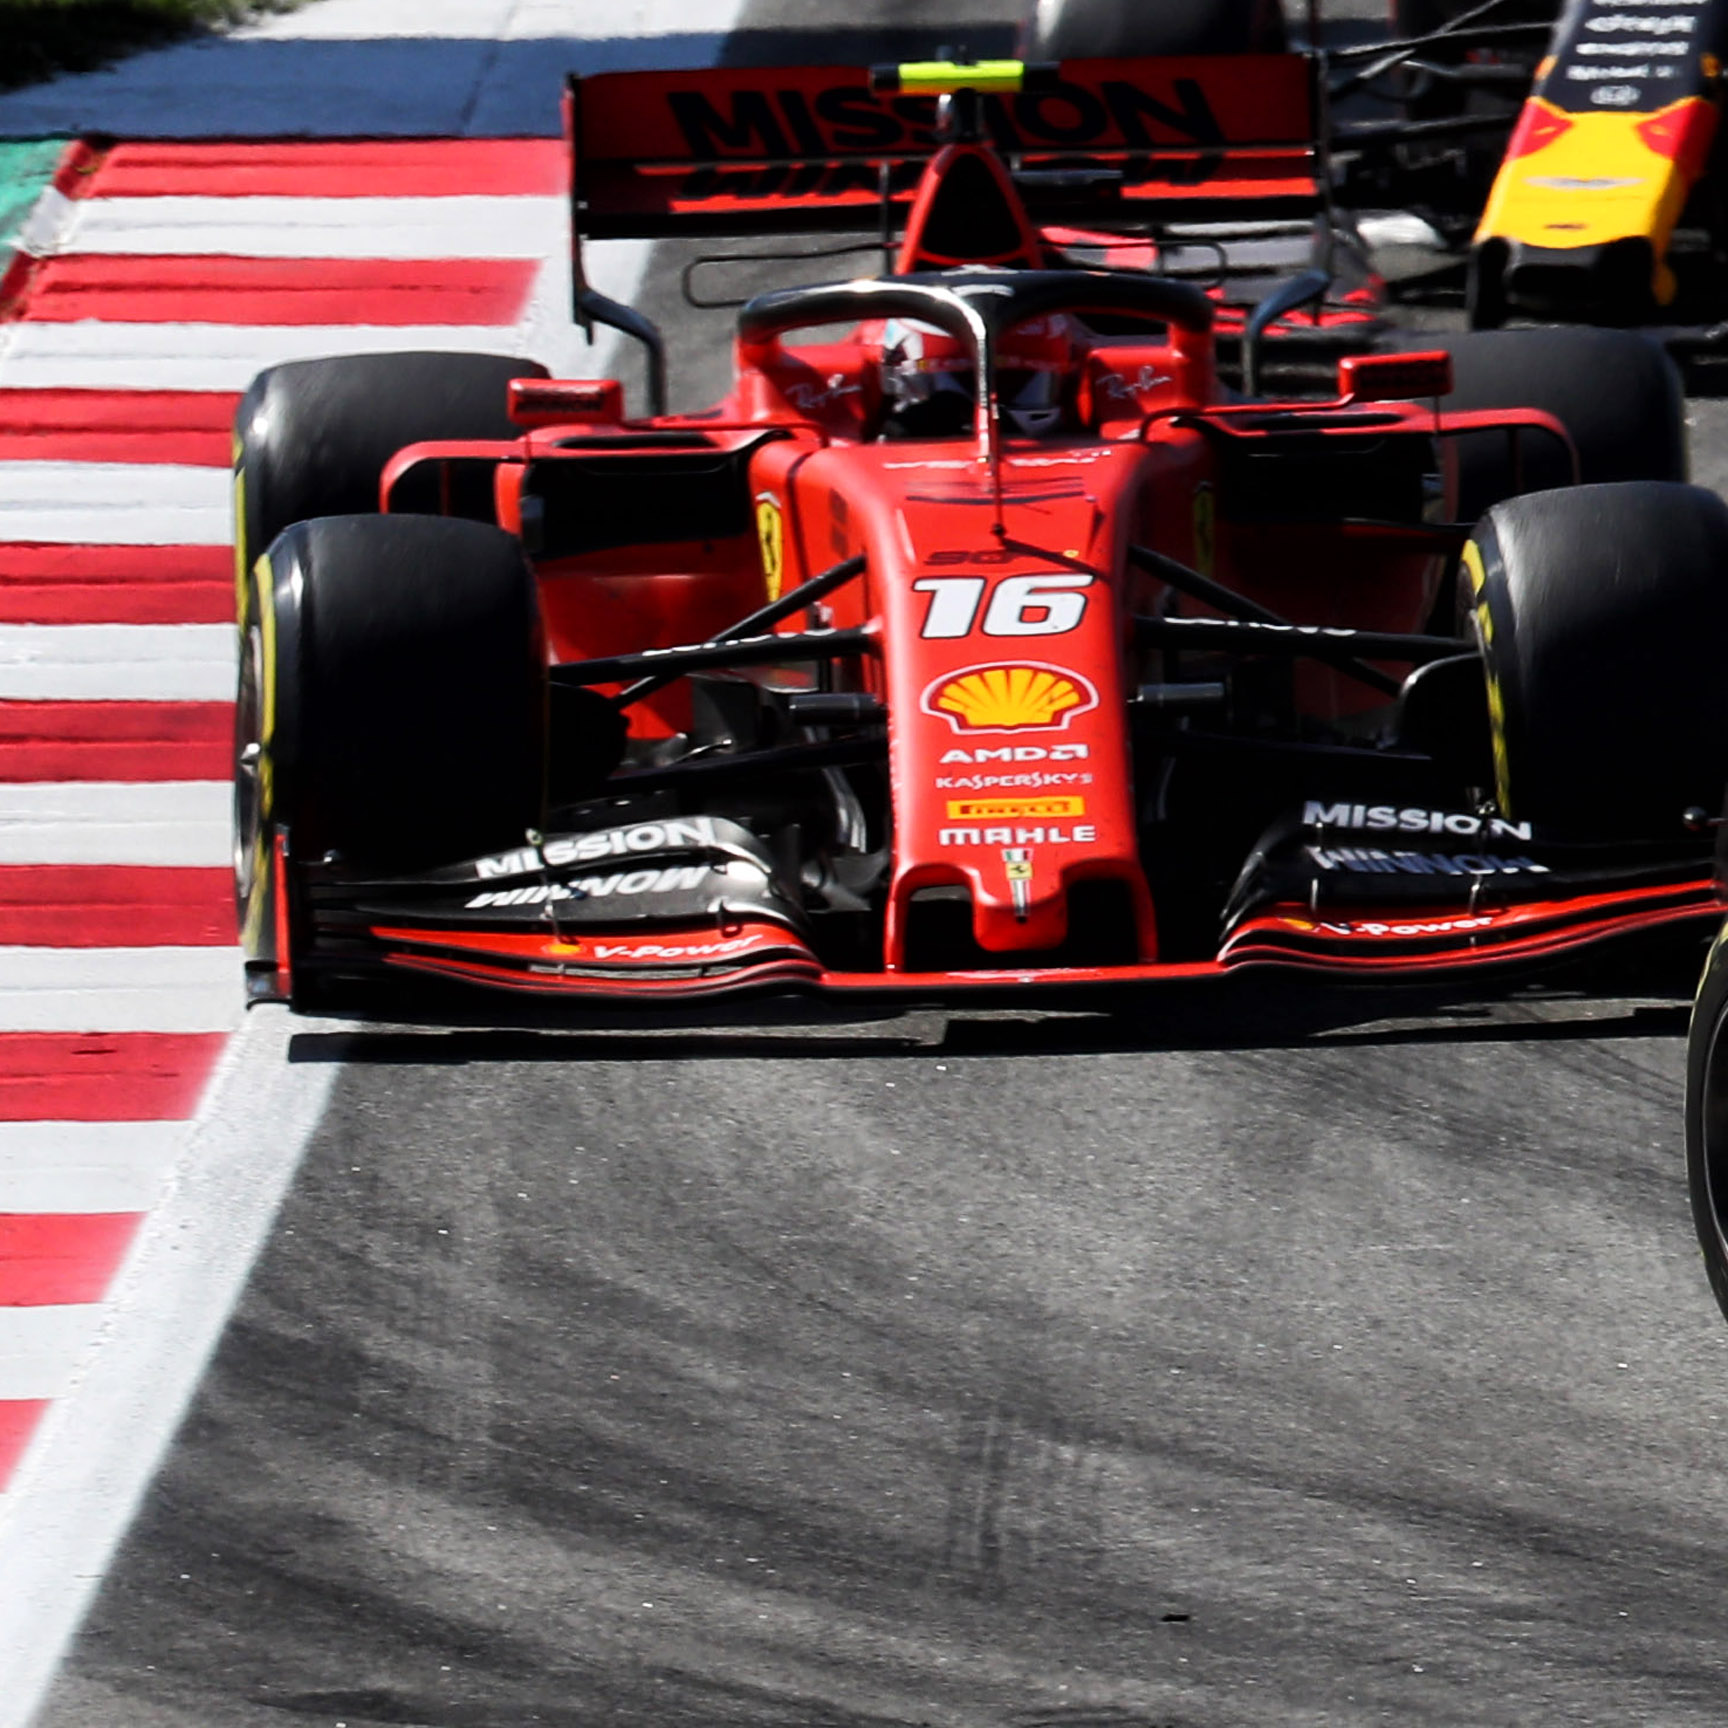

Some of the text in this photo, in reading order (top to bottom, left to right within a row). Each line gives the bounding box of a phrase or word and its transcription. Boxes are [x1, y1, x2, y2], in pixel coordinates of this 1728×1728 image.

[912, 572, 1097, 640] 16
[939, 746, 1048, 764] AMD
[936, 771, 1080, 790] KASPERSKY
[1302, 800, 1532, 841] MISSION
[475, 816, 719, 879] MISSION
[939, 825, 1096, 846] MAHLE
[592, 933, 766, 961] V-Power
